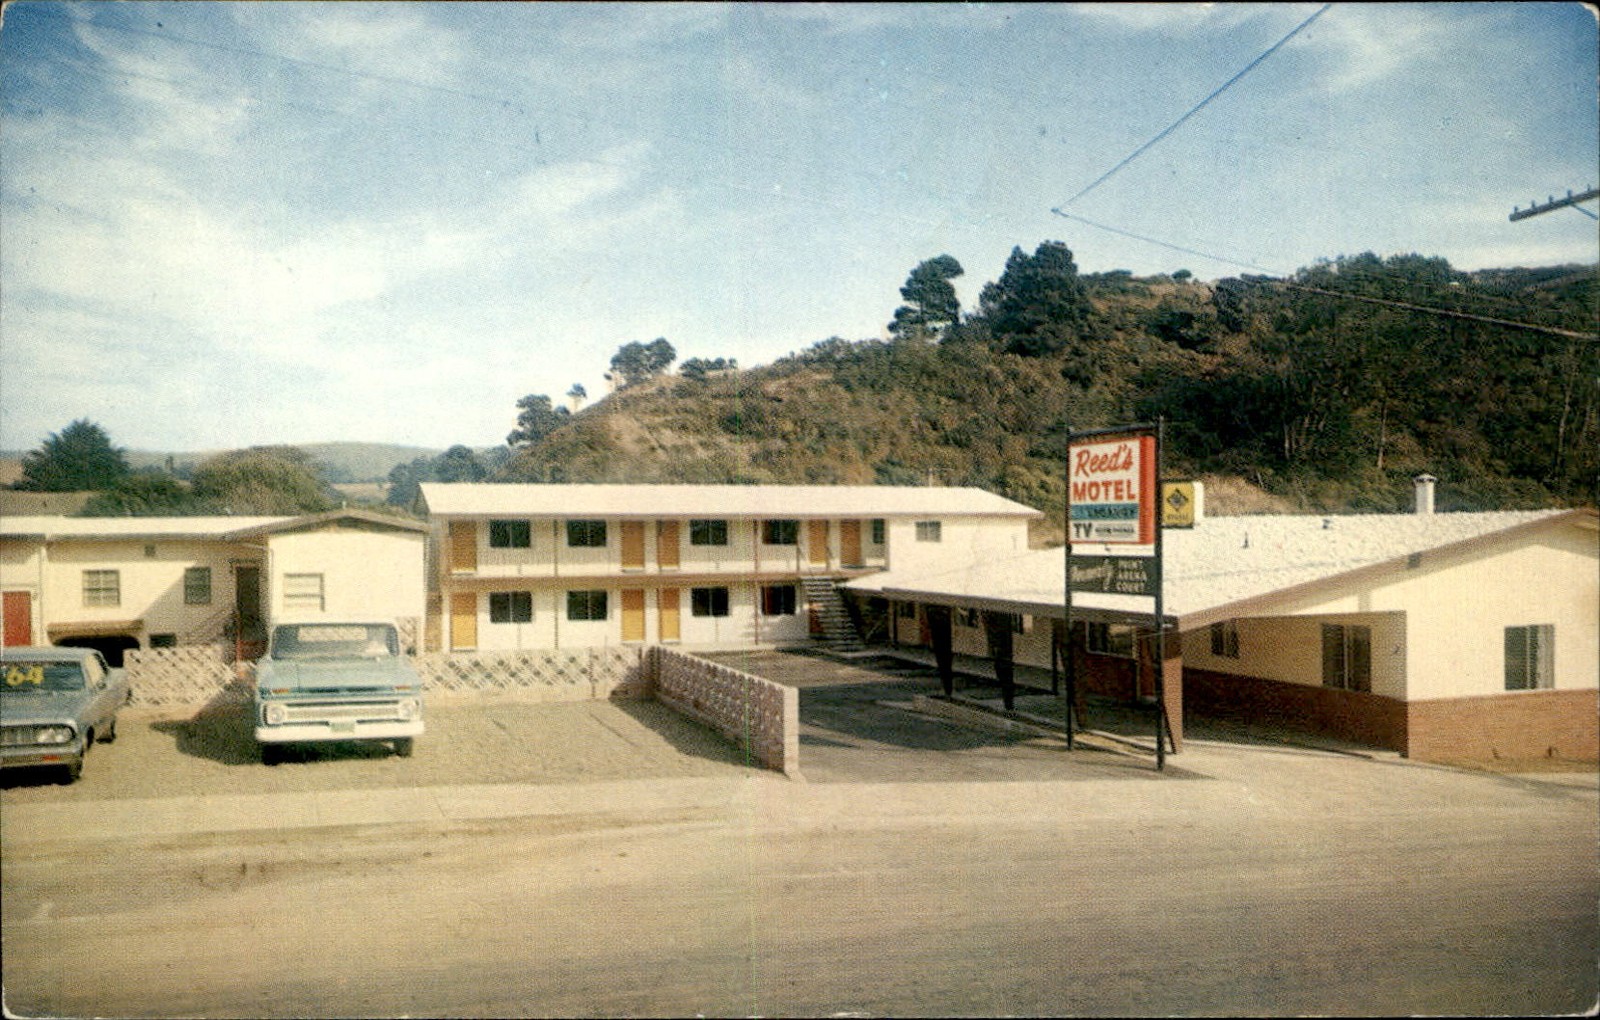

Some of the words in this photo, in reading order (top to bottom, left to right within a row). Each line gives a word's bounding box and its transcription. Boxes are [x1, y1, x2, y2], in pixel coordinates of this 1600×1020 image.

[1074, 444, 1134, 478] Reed's
[1072, 479, 1136, 502] MOTEL
[1073, 522, 1093, 539] TV
[6, 664, 45, 687] 64
